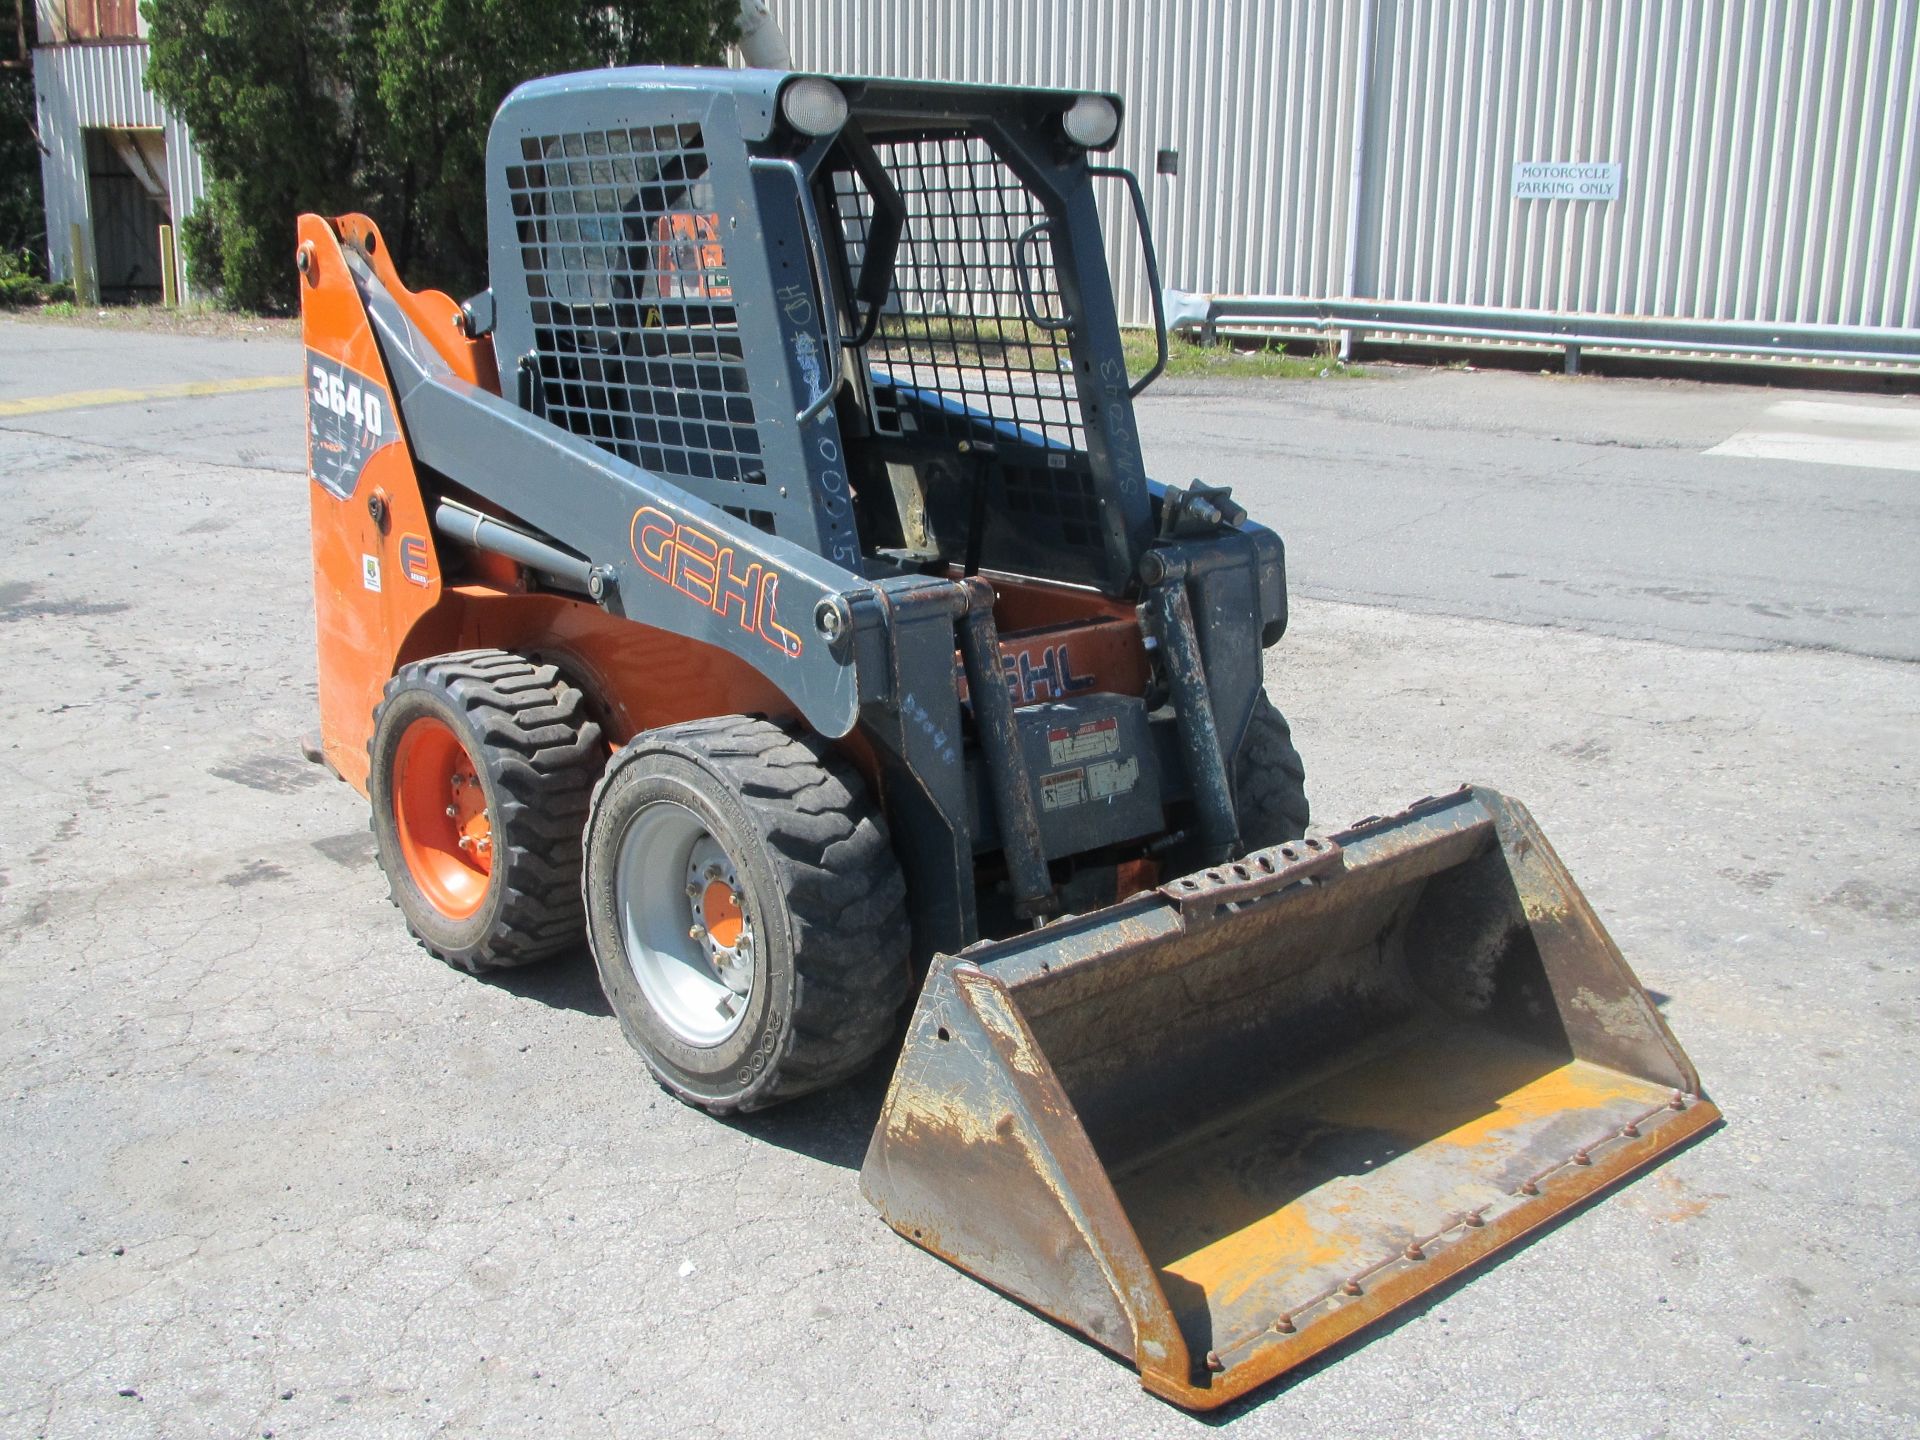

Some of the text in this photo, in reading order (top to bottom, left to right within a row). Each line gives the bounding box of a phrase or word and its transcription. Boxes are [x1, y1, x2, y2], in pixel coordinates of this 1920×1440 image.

[1516, 181, 1615, 195] PARKING ONLY
[1521, 166, 1610, 180] MOTORCYCLE
[312, 365, 382, 436] 3640
[630, 505, 802, 658] GEHL
